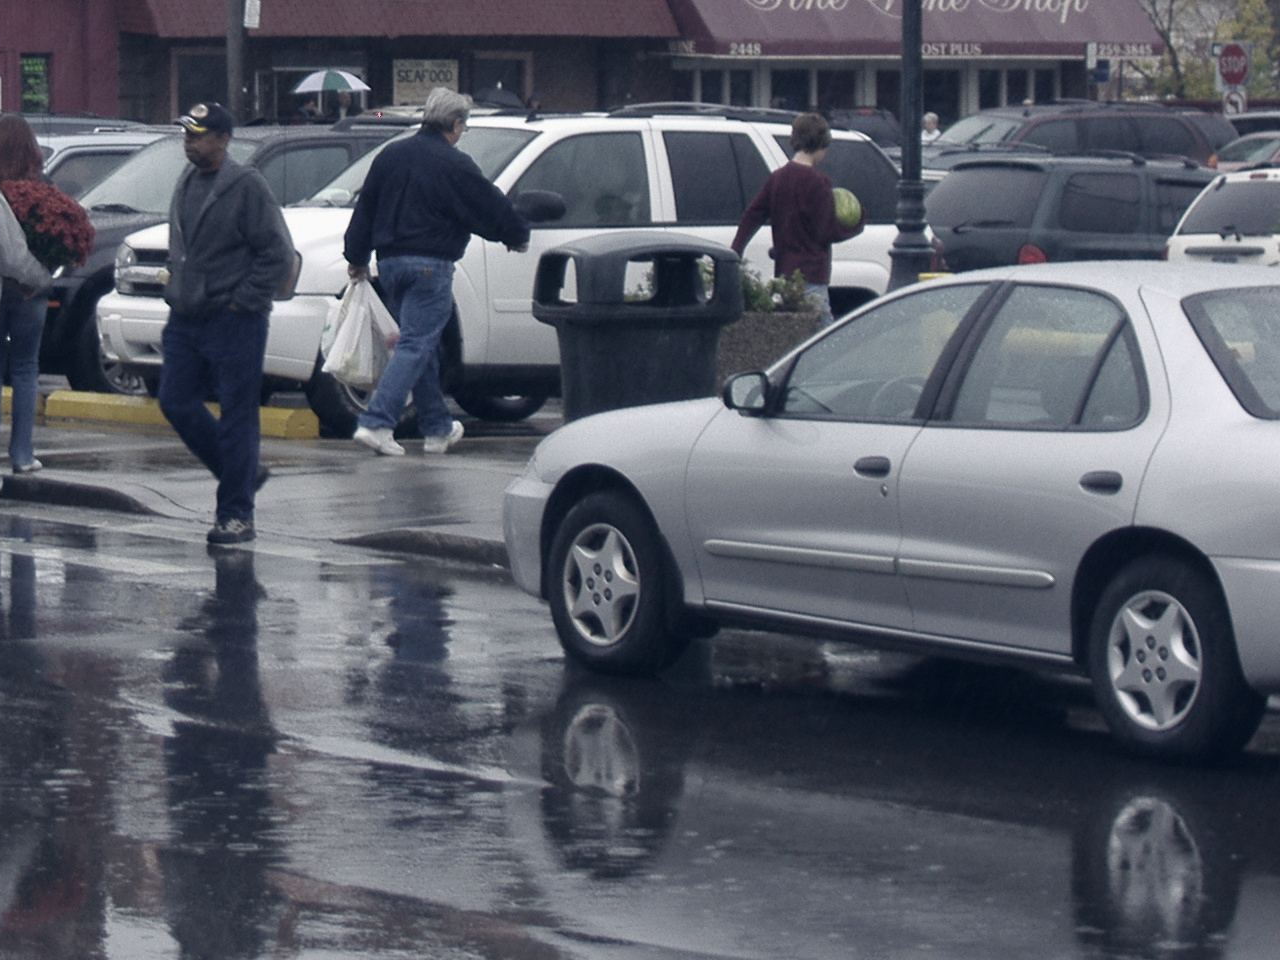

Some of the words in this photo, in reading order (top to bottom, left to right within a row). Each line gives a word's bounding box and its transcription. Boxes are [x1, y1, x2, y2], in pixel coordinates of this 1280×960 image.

[729, 42, 762, 55] 2448
[922, 42, 946, 55] OST
[949, 43, 983, 56] PLUS
[1220, 55, 1247, 73] STOP
[397, 69, 454, 83] SEAFOOD
